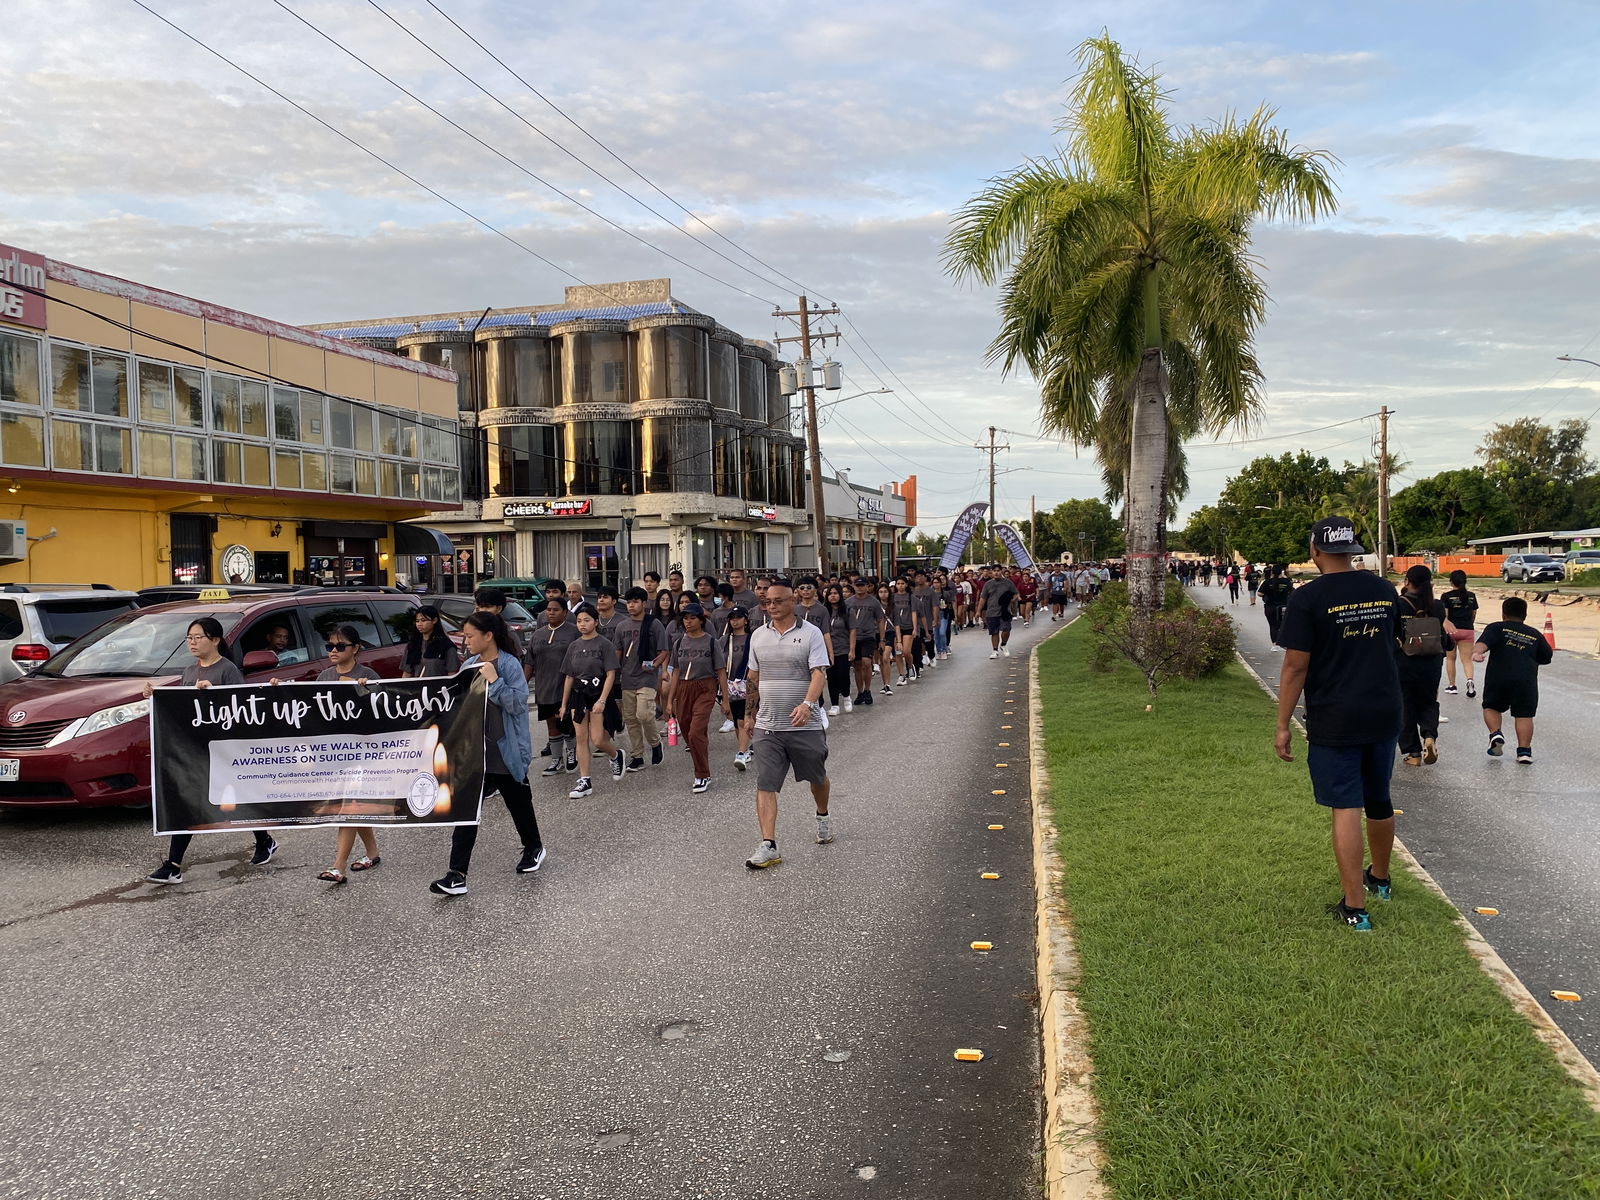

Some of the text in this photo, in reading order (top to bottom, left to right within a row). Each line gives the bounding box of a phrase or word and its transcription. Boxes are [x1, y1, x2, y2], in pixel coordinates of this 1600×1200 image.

[0, 287, 24, 318] 店
[504, 505, 545, 515] CHEERS
[1327, 605, 1348, 614] LIGHT
[192, 683, 458, 730] Light up the Night
[249, 747, 273, 755] JOIN
[276, 745, 290, 753] US
[293, 744, 307, 753] AS
[310, 743, 327, 751] WE
[330, 742, 363, 751] WALK
[381, 740, 411, 749] RAISE
[232, 750, 422, 766] AWARENESS ON SUICIDE PREVENTION
[237, 772, 276, 780] Community
[339, 768, 362, 776] Suicide
[362, 767, 396, 775] Prevention
[396, 767, 419, 775] Program
[271, 777, 324, 786] Commonwealth
